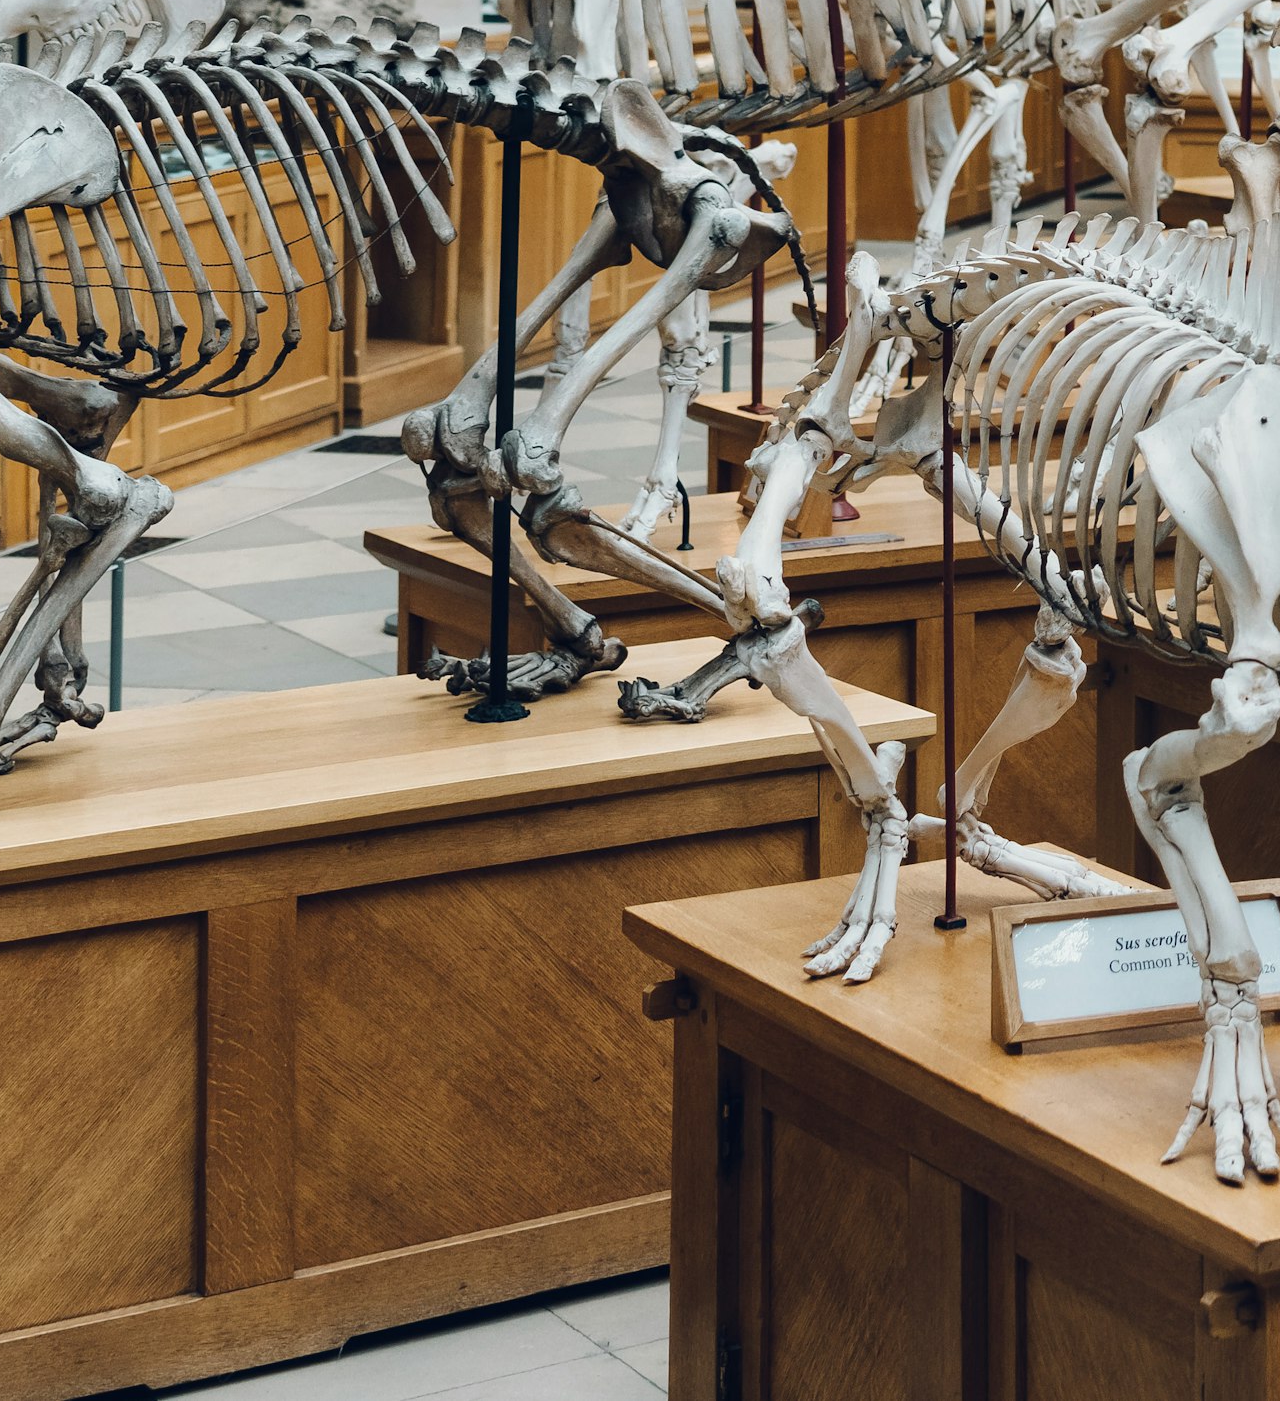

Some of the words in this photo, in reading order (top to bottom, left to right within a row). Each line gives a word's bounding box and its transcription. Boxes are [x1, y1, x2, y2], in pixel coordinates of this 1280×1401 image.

[1115, 937, 1140, 951] Sus
[1145, 931, 1188, 948] scrofa
[1109, 955, 1172, 974] Common
[1176, 951, 1200, 969] Pig
